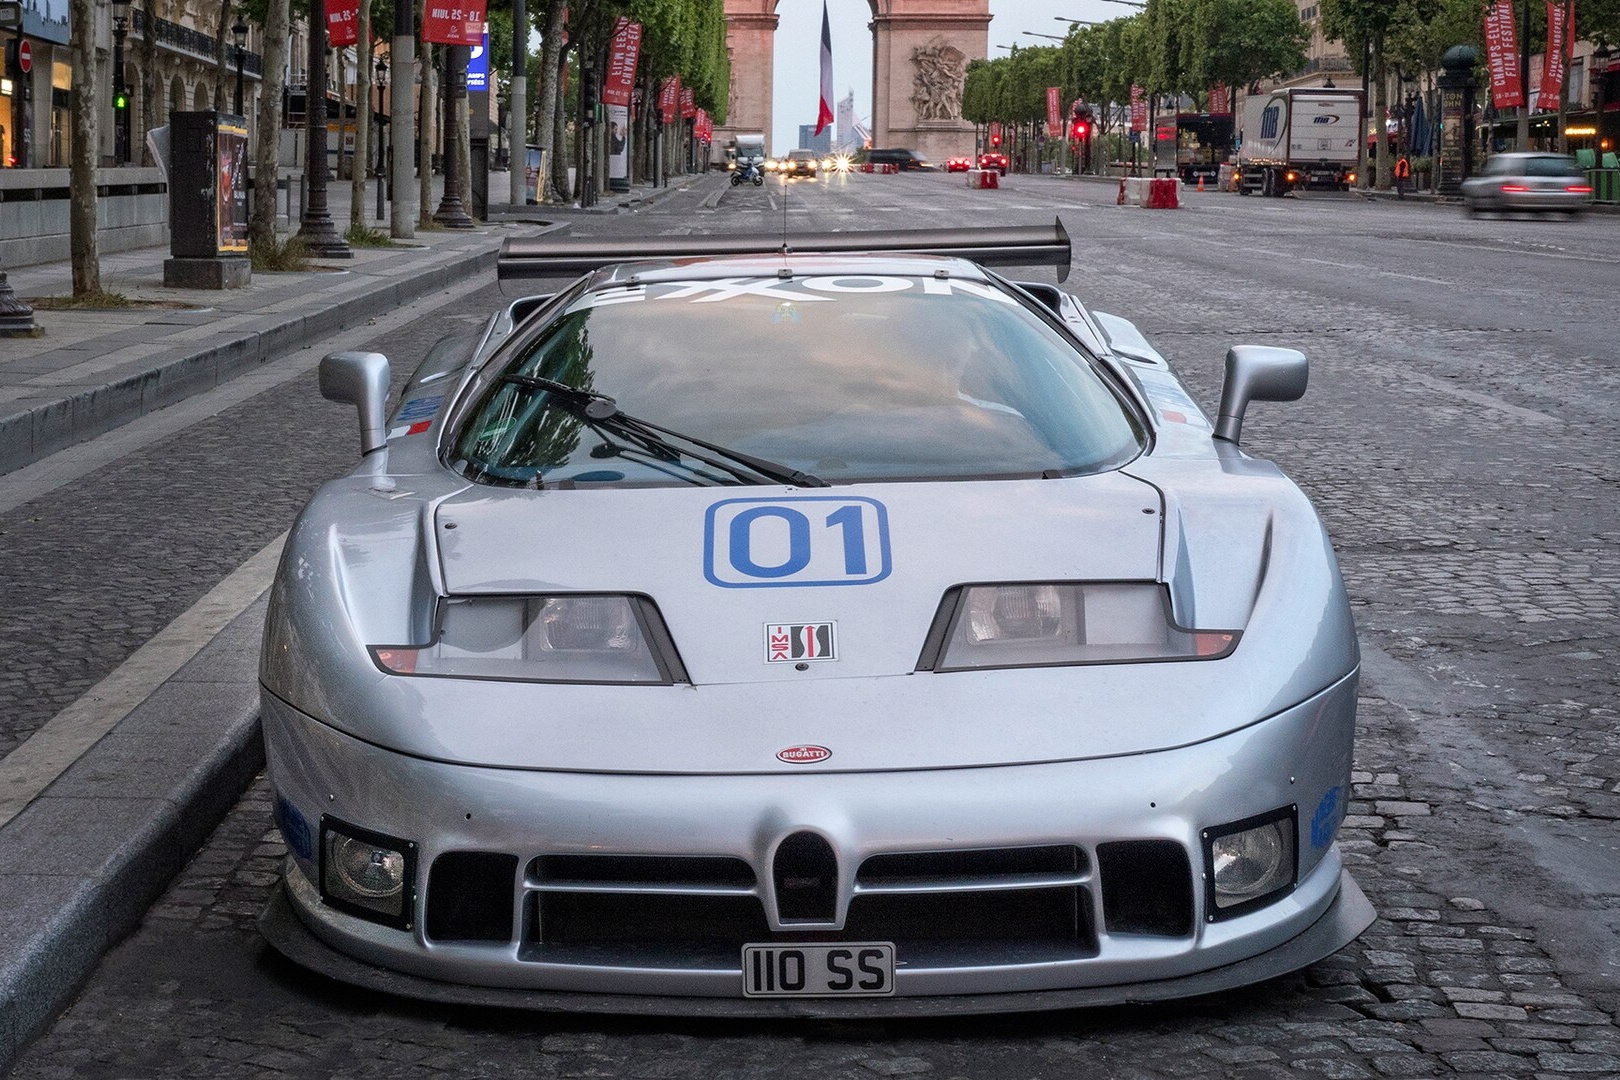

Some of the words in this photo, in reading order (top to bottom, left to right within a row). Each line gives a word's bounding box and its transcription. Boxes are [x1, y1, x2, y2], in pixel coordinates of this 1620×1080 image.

[1498, 3, 1514, 48] FESTIVAL
[1553, 5, 1561, 47] INDÉPENDA
[1503, 52, 1517, 77] FILM
[1548, 49, 1560, 77] CINÉMA
[729, 506, 867, 578] 01
[771, 626, 789, 660] IMSA
[782, 750, 825, 759] BUGATTI
[827, 949, 885, 991] SS
